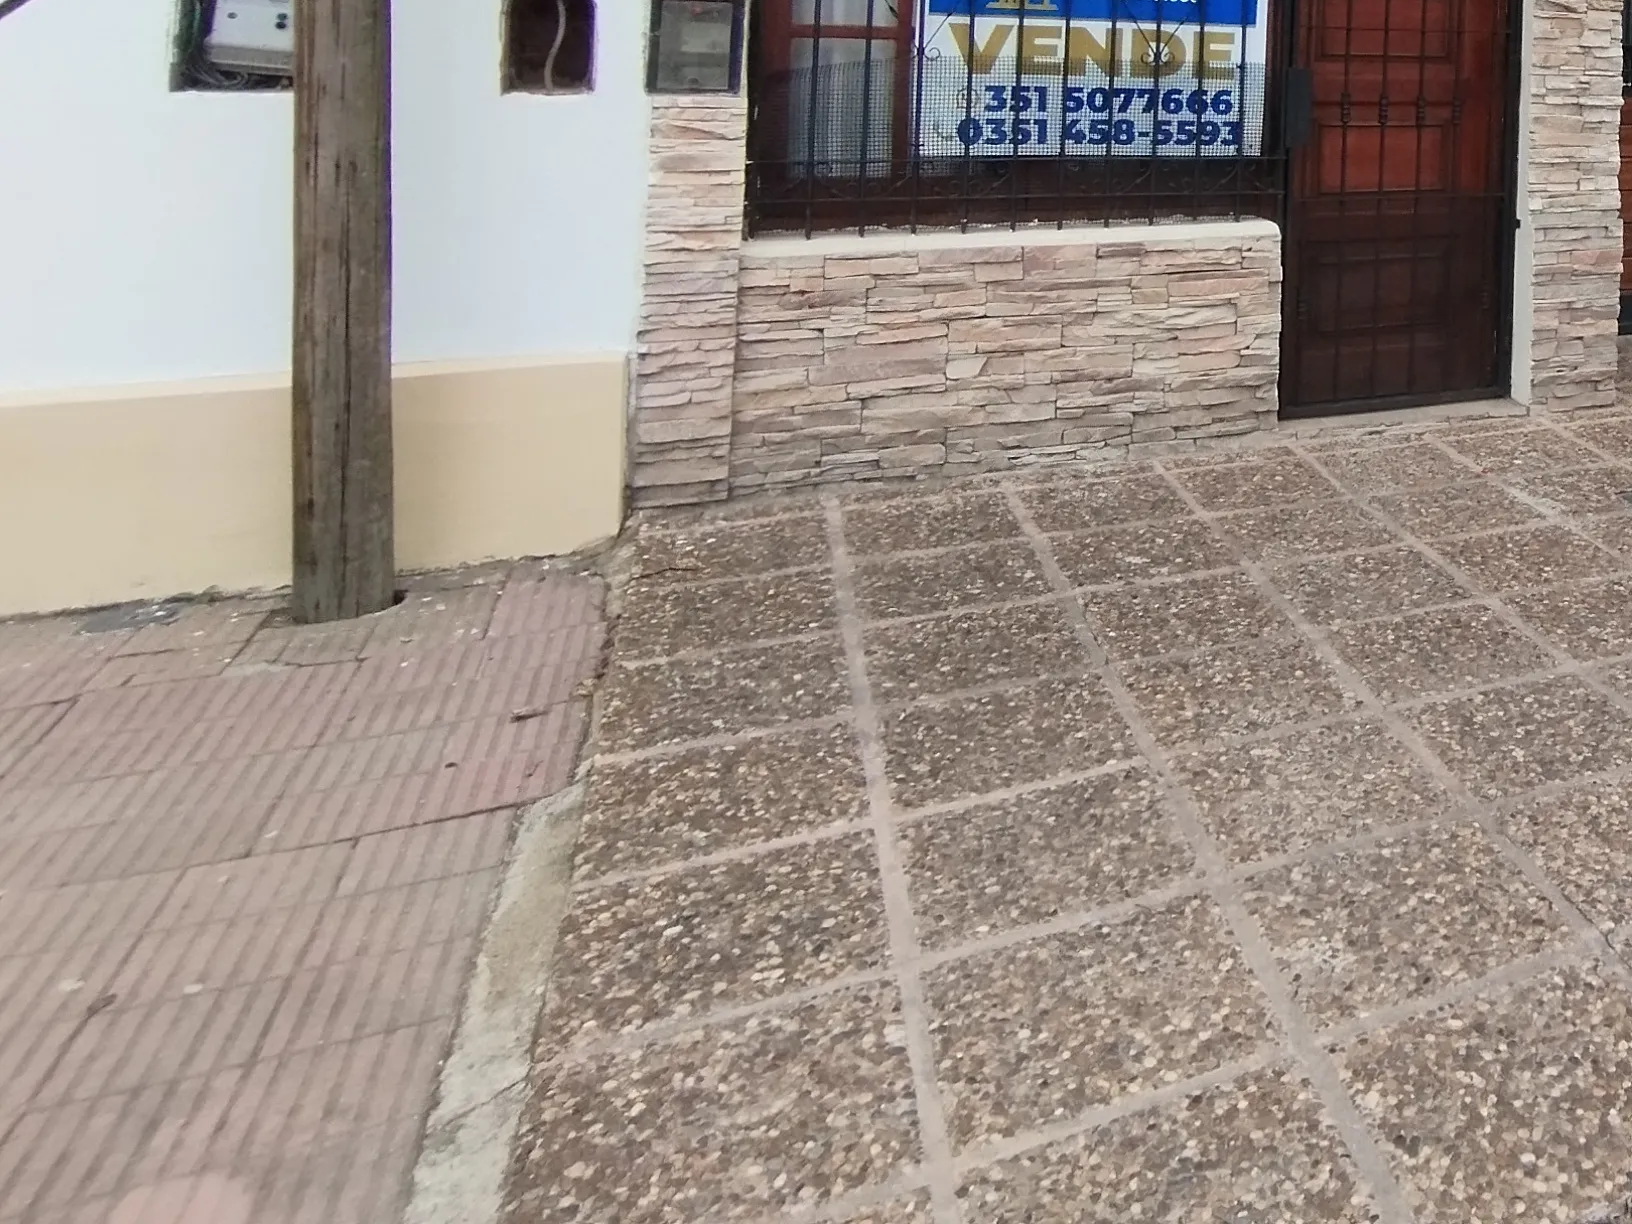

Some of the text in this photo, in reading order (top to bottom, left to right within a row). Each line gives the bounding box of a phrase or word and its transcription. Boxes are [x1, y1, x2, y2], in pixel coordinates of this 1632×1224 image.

[949, 22, 1236, 80] VENDE
[984, 85, 1233, 116] 351 5077666
[957, 117, 1048, 146] 0351
